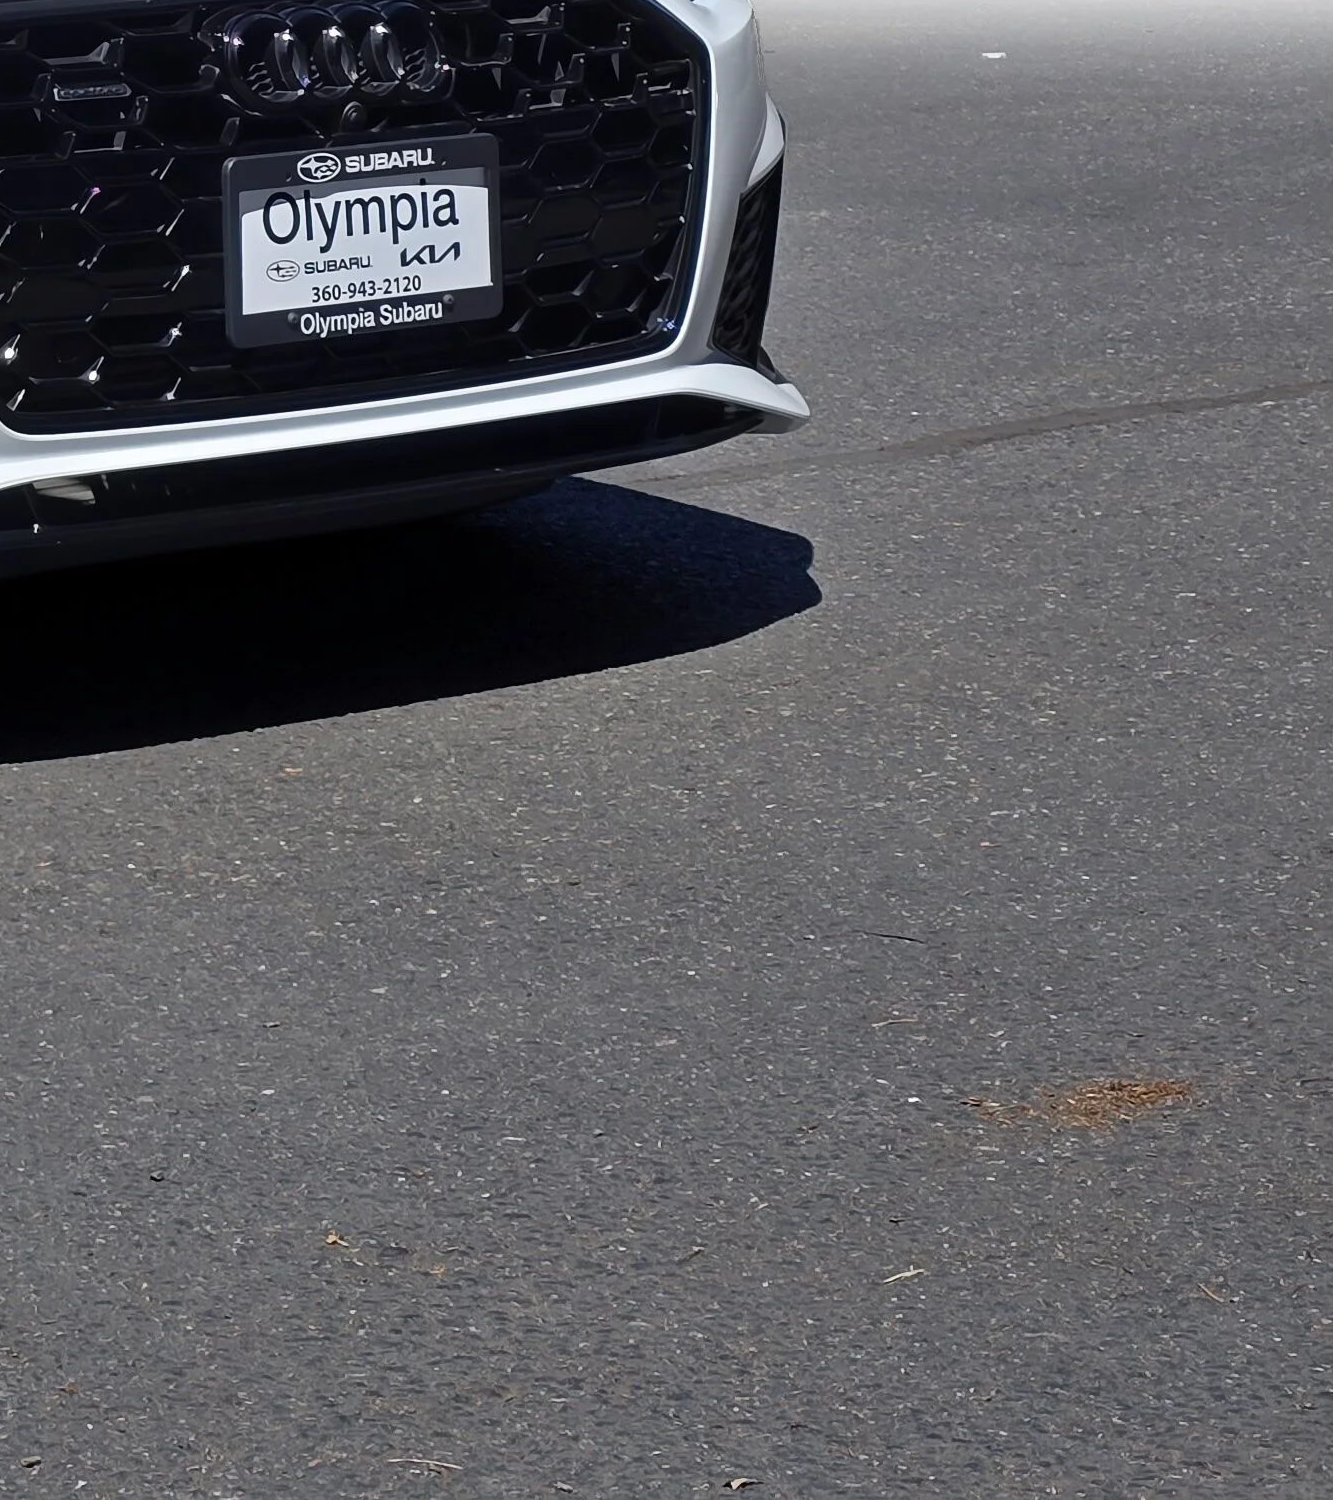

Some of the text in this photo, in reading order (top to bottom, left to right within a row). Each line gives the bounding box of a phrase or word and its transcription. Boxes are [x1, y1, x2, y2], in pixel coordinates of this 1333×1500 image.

[262, 178, 460, 254] Olympia
[311, 274, 423, 304] 360-943-2120
[299, 301, 444, 339] Olympia Subaru
